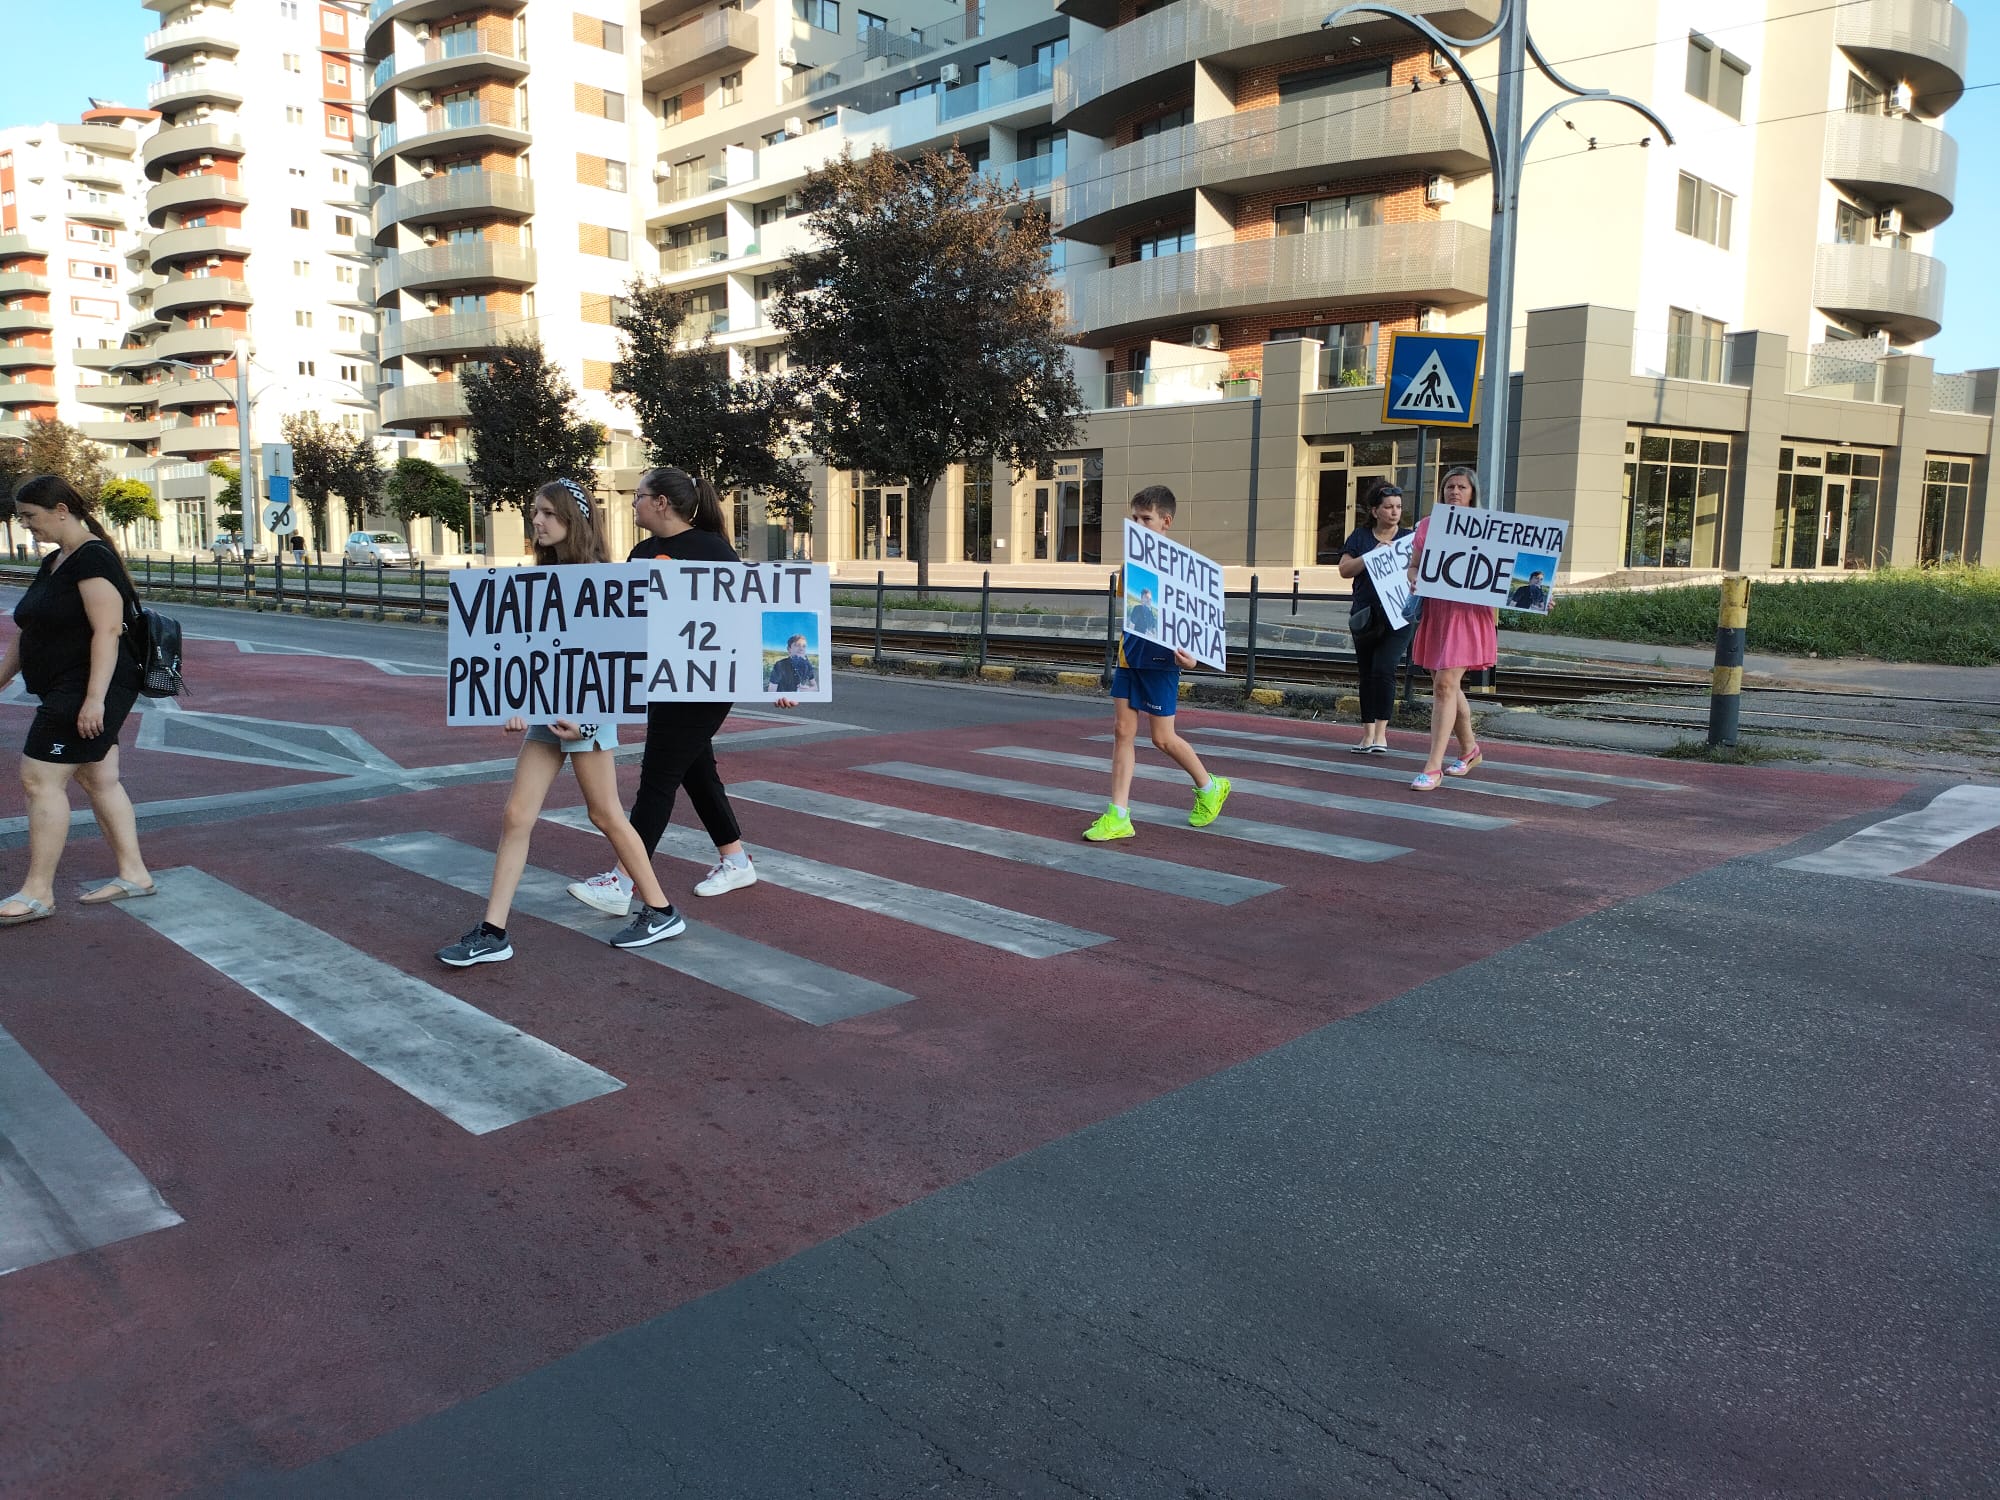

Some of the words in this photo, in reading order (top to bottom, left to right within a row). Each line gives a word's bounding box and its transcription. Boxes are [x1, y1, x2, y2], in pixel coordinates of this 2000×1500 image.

[271, 511, 290, 526] 30
[648, 568, 668, 600] A
[680, 562, 812, 604] TRĂIT
[1129, 526, 1219, 600] DREPTATE
[1366, 550, 1399, 581] VREM
[1421, 545, 1514, 595] UCIDE
[573, 577, 649, 618] ARE
[1164, 584, 1225, 631] PENTRU
[678, 620, 721, 651] 12
[1162, 608, 1224, 664] HORIA
[449, 638, 648, 717] PRIORITATE
[648, 648, 737, 693] ANI
